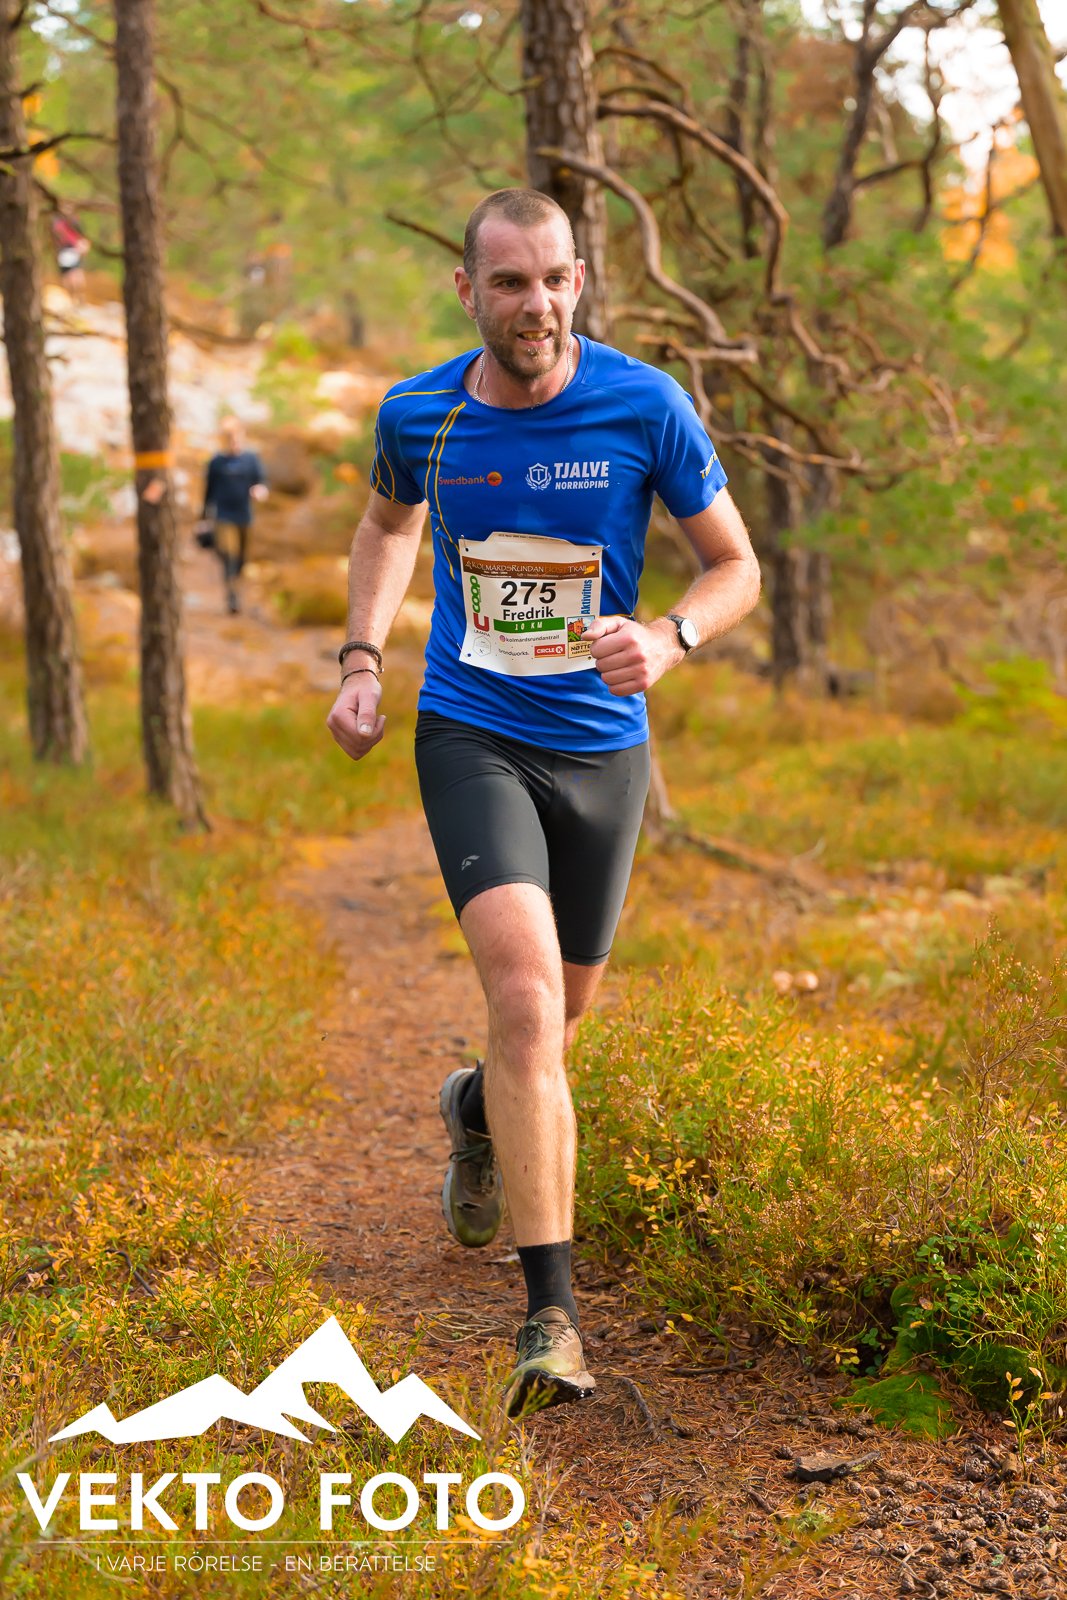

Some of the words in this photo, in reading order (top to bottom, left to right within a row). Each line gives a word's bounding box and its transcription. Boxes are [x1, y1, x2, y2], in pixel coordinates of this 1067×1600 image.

[554, 461, 610, 479] TJALVE
[438, 475, 485, 486] Swedbank
[555, 479, 609, 490] NORRKÖPING
[470, 575, 481, 613] coop
[500, 581, 556, 606] 275
[581, 579, 592, 614] Aktivitus
[503, 606, 554, 620] Fredrik
[515, 623, 525, 631] 10
[530, 621, 543, 629] KM
